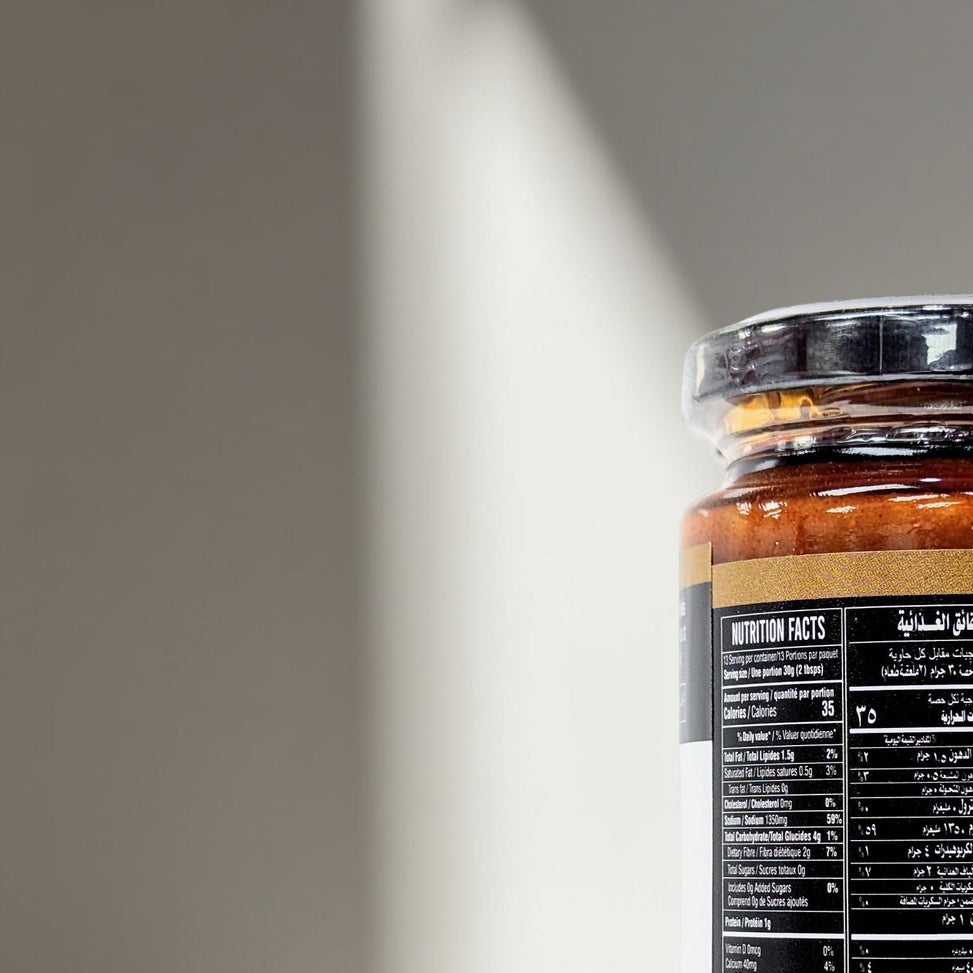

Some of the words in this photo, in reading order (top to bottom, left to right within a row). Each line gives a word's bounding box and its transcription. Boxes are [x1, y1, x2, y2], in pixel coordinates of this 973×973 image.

[732, 618, 784, 646] NUTRITION
[788, 616, 826, 640] FACTS
[897, 609, 950, 637] الغذائية
[762, 666, 782, 678] portion
[784, 665, 795, 678] 30g
[796, 664, 803, 677] (2
[804, 663, 824, 676] tbsps)
[724, 706, 746, 720] Calories
[752, 704, 778, 718] Calories
[822, 700, 834, 717] 35
[856, 705, 877, 727] ٣٥
[826, 814, 842, 824] 59%
